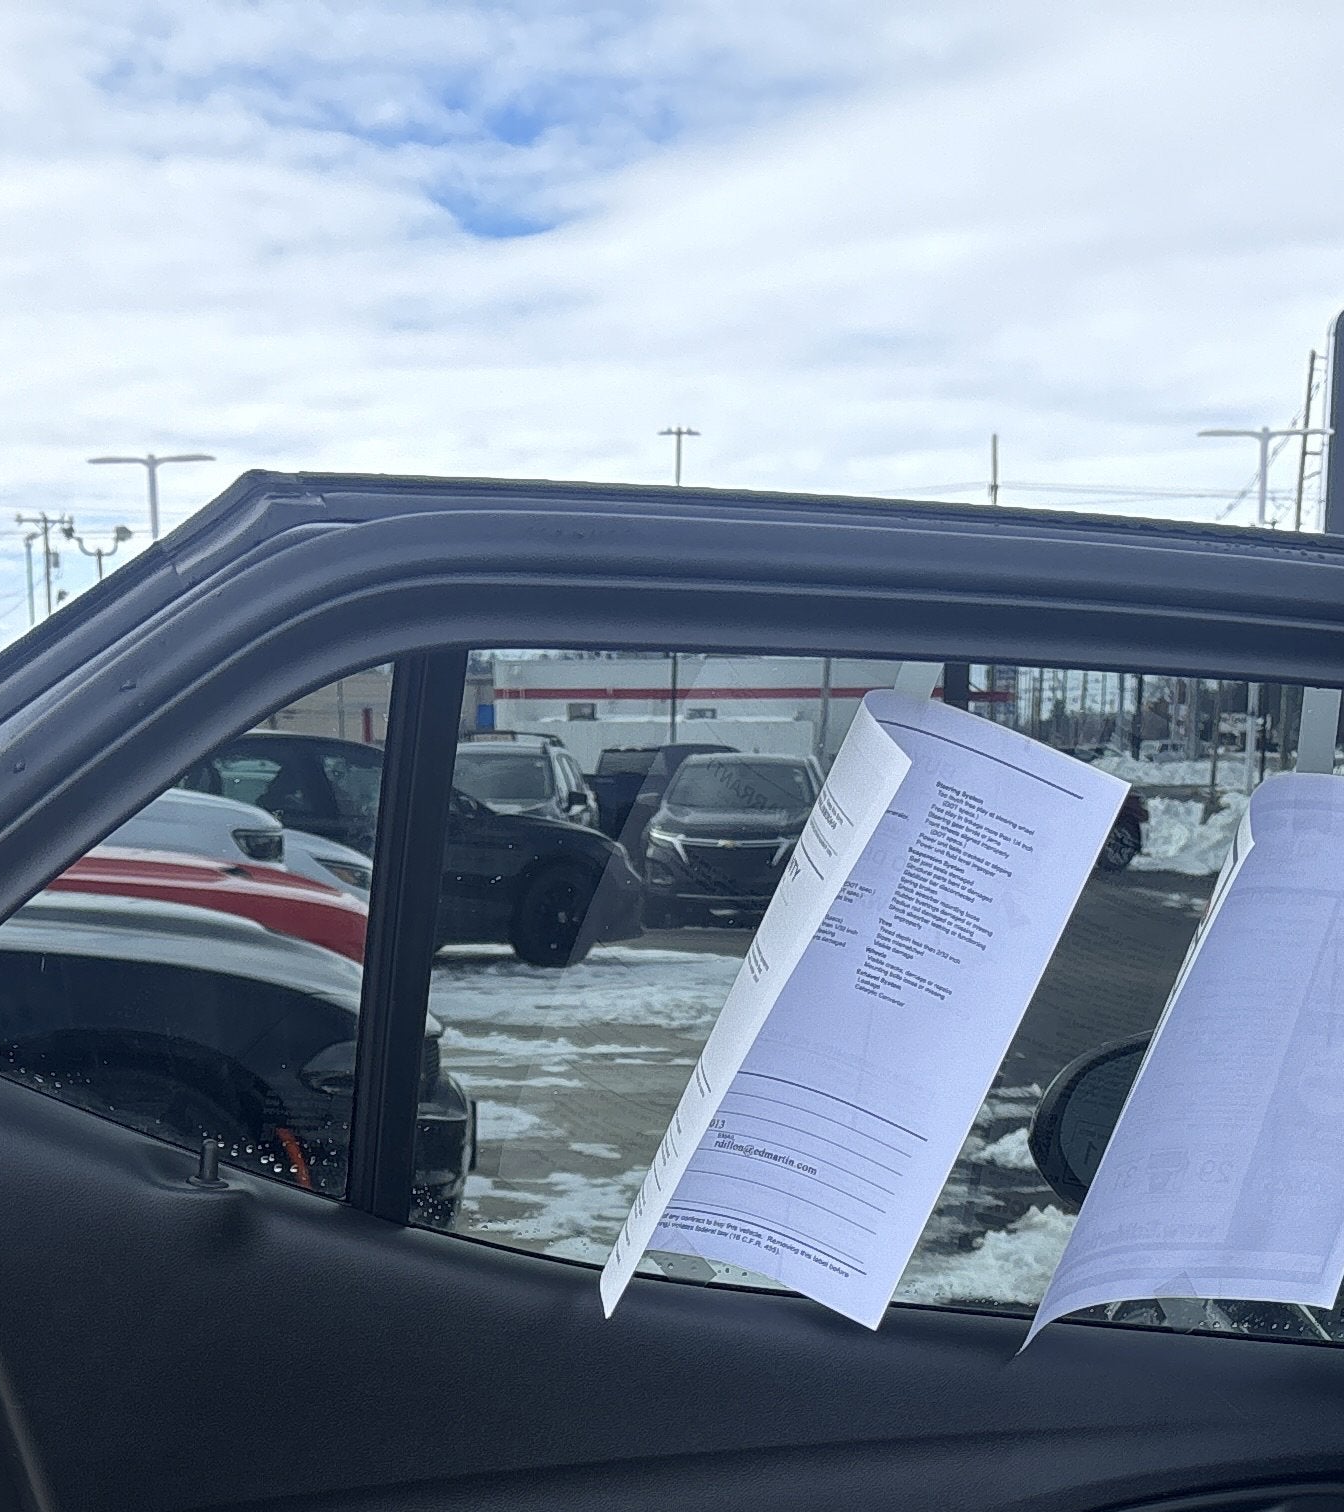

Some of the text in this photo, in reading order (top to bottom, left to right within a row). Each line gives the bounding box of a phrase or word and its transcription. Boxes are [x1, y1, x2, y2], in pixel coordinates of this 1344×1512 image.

[714, 1139, 818, 1176] rdillon@edmartin.com
[767, 1236, 800, 1255] Removing
[829, 1263, 850, 1278] before
